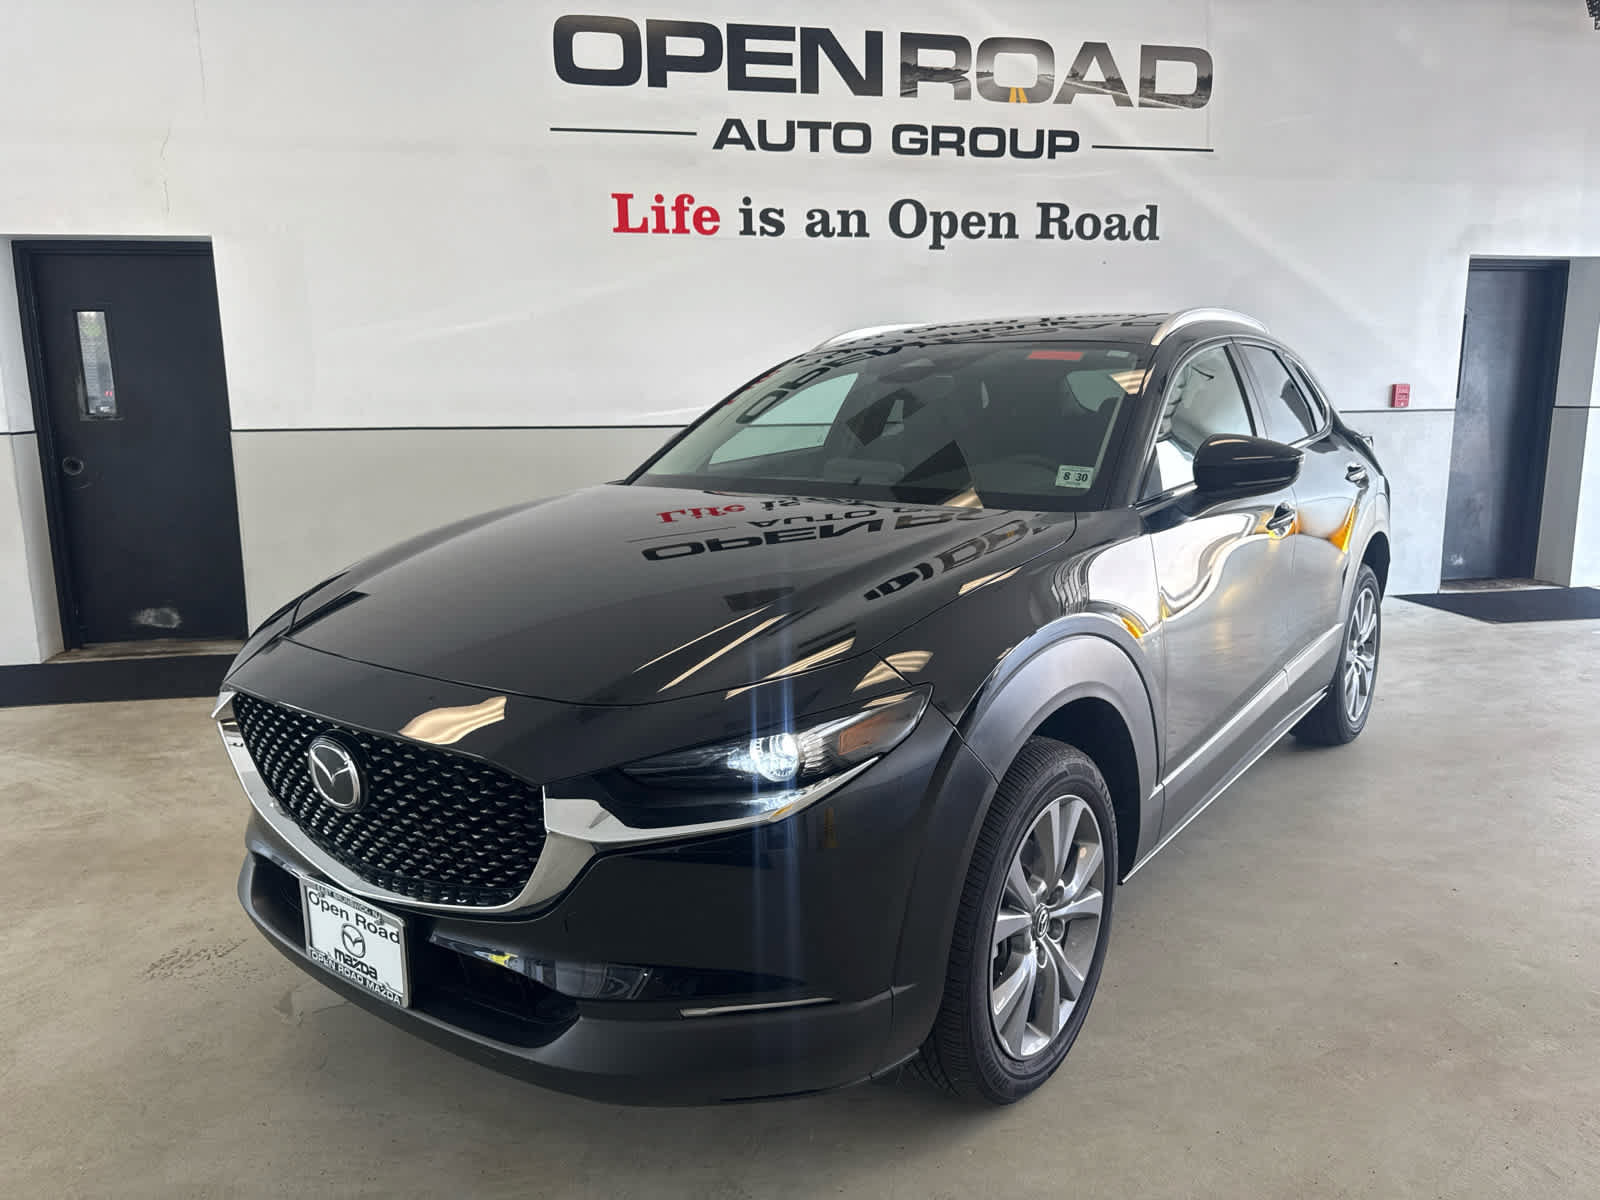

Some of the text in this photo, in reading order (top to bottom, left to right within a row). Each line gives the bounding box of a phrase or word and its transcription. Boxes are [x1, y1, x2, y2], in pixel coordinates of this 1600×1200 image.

[552, 14, 1215, 110] OPEN ROAD
[712, 118, 1080, 160] AUTO GROUP
[611, 192, 1161, 251] Life is an Open Road
[308, 890, 350, 922] Open
[355, 912, 401, 945] Road
